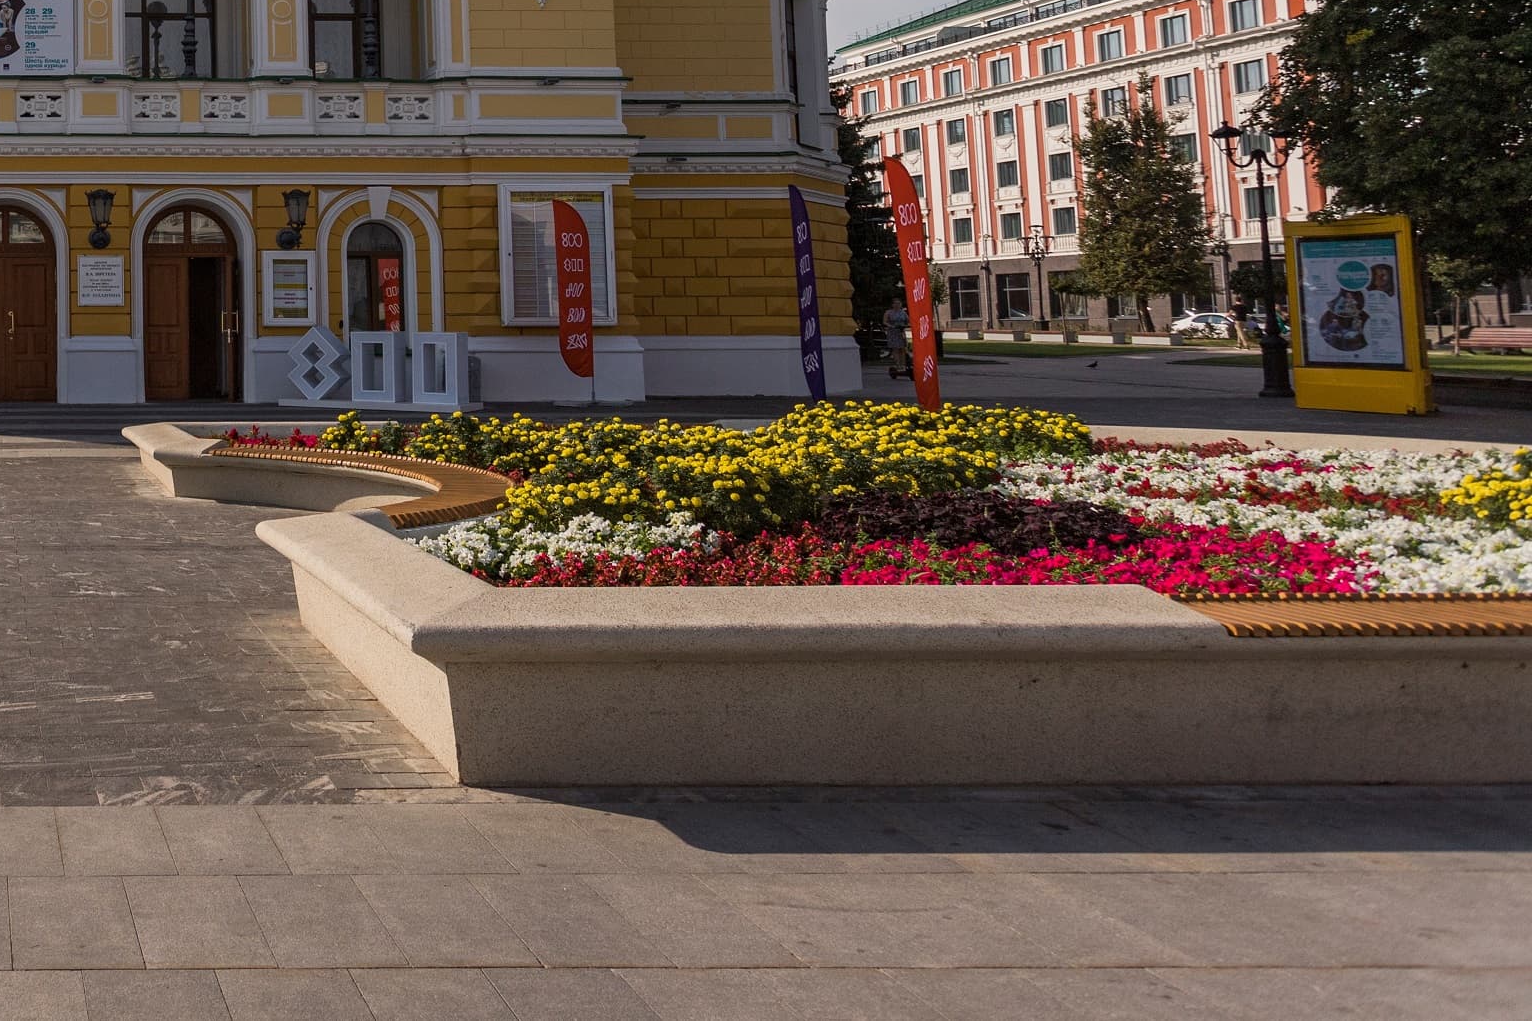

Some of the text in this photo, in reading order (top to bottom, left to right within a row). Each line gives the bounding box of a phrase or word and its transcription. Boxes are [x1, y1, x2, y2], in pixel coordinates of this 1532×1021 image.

[898, 202, 917, 227] 800
[561, 232, 583, 248] 800
[563, 258, 584, 272] 800
[287, 326, 469, 406] 800
